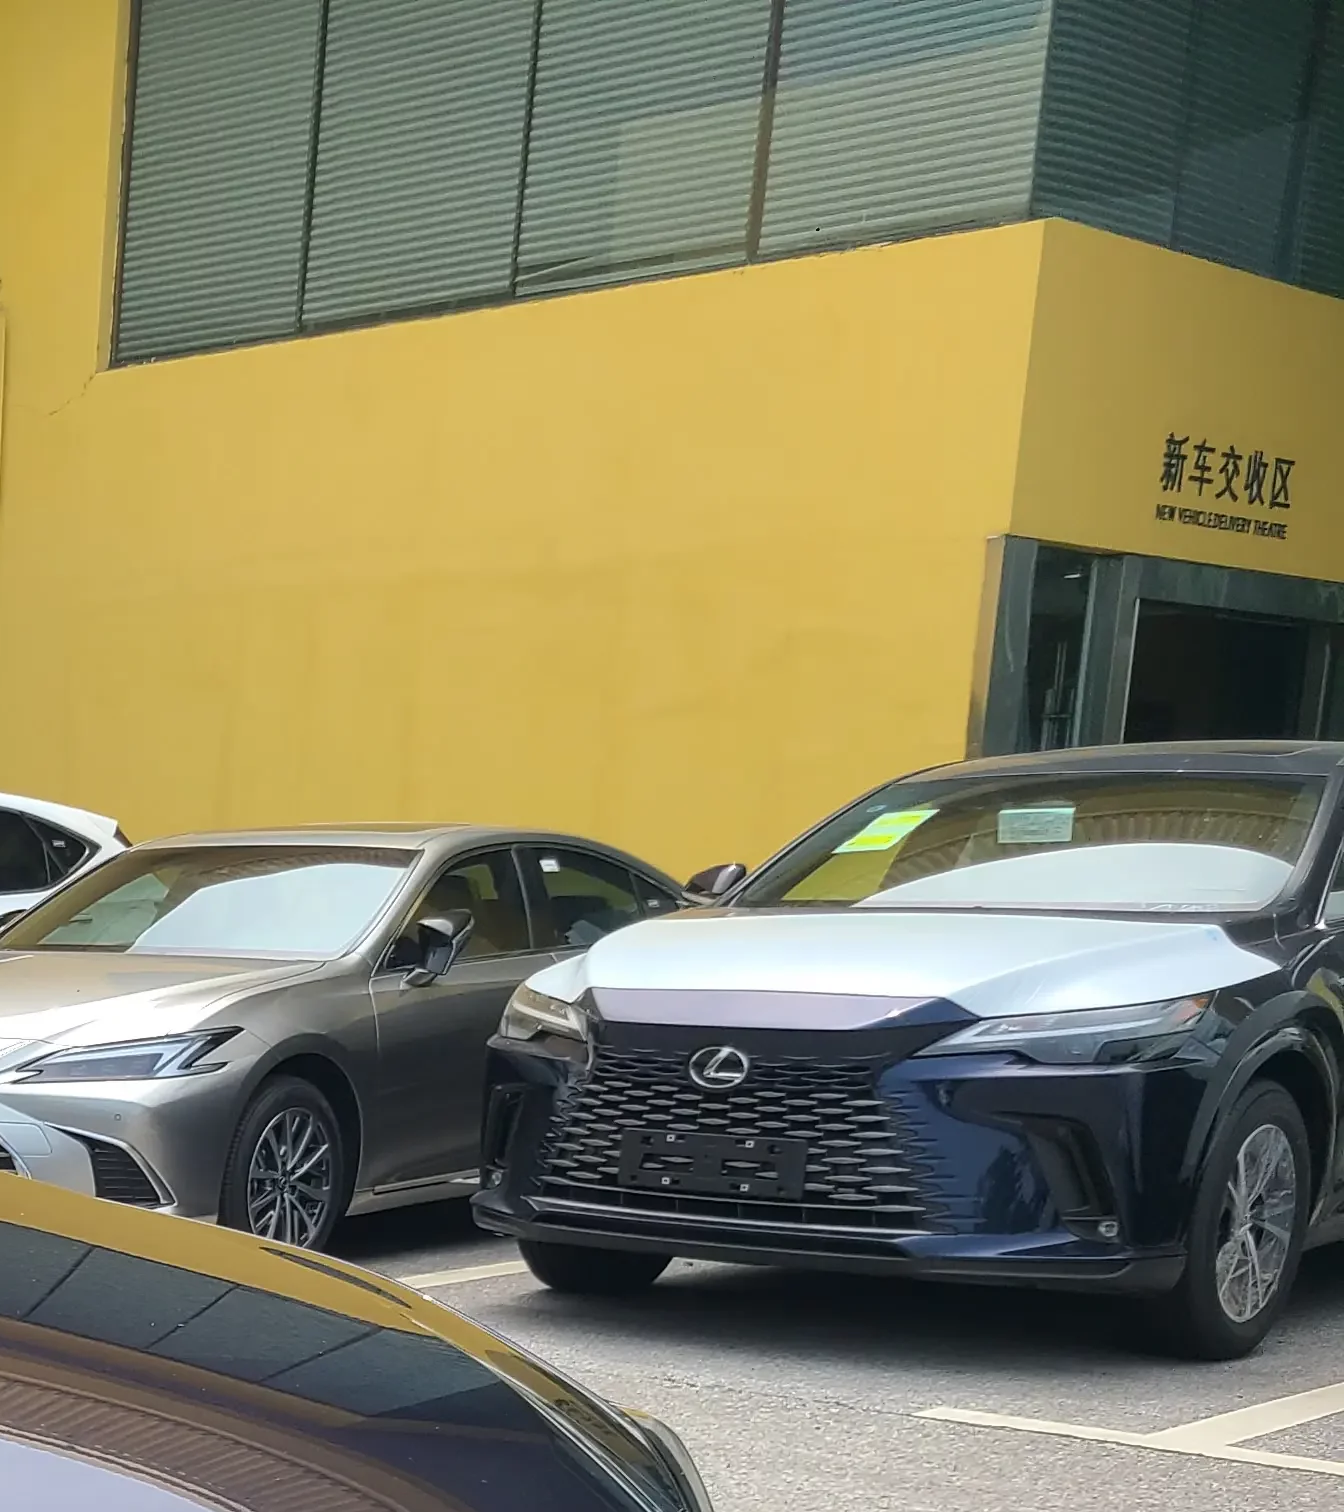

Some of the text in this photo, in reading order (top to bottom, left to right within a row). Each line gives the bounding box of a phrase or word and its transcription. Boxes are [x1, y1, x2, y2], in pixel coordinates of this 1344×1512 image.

[1160, 432, 1296, 509] 新车交收区
[1155, 504, 1177, 521] NEW
[1253, 518, 1289, 540] THEATRE
